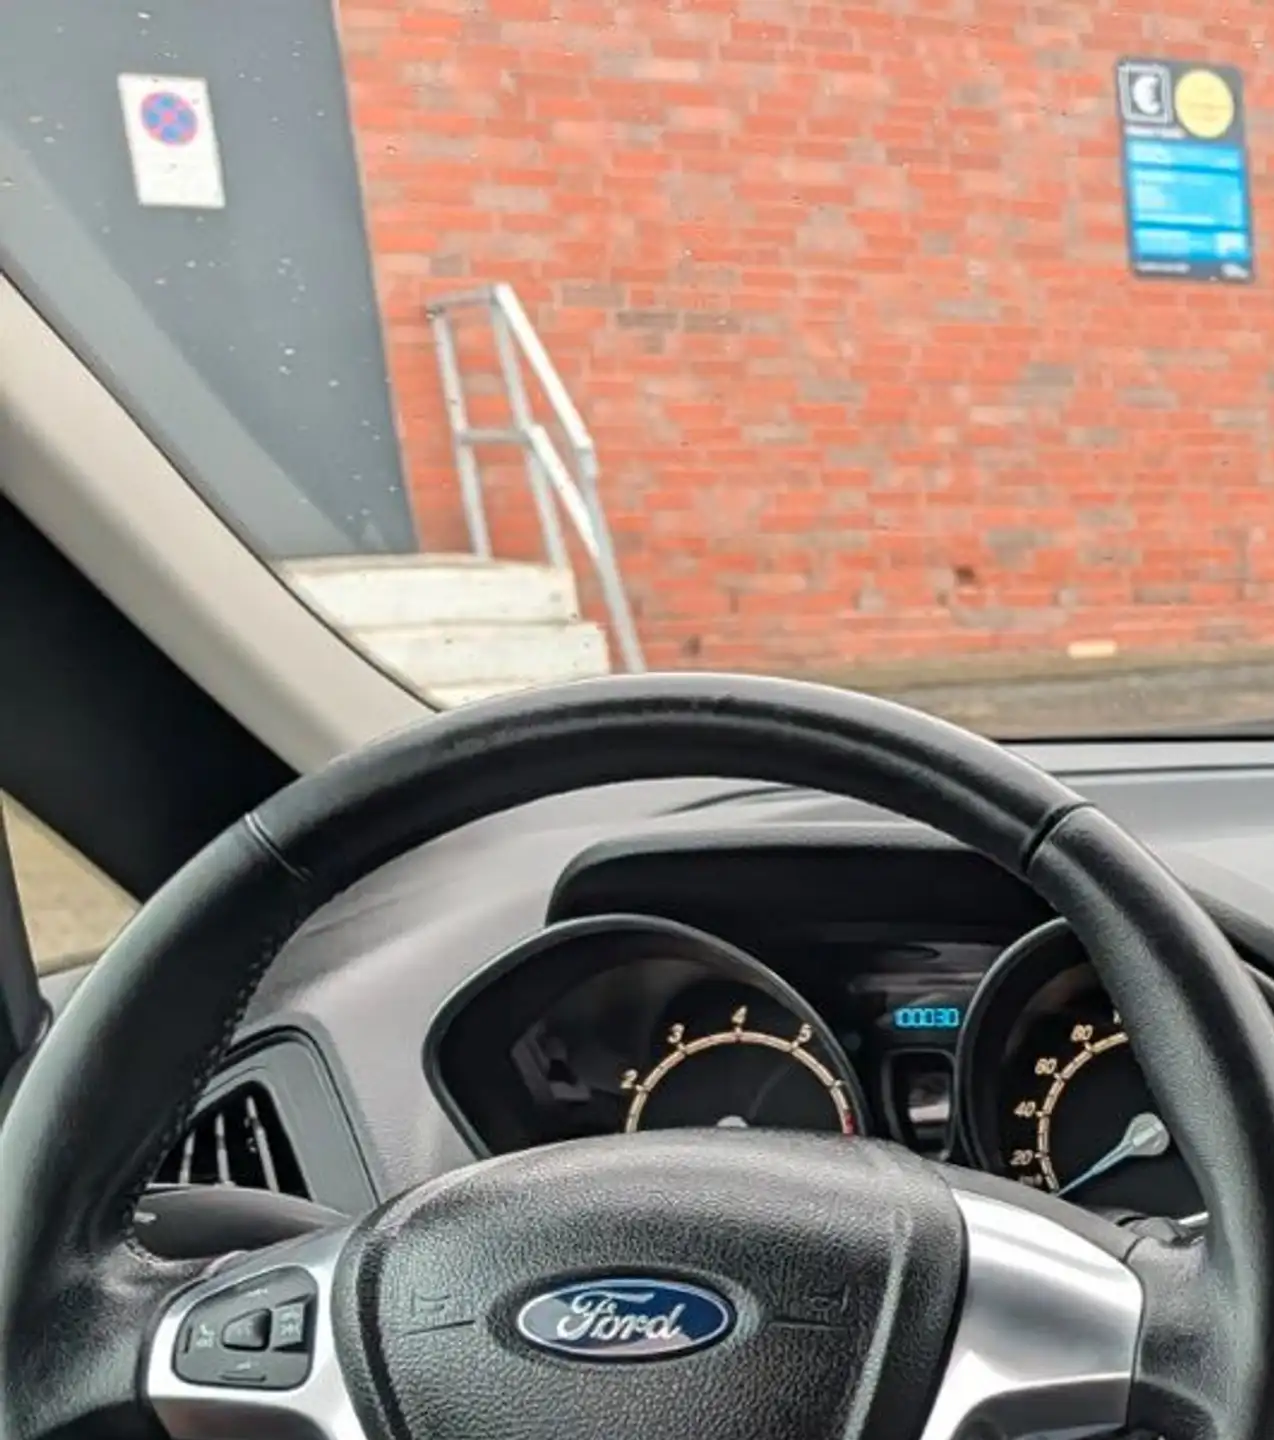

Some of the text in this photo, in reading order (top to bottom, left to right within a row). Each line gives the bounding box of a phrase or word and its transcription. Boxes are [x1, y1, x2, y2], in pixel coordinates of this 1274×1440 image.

[731, 1004, 747, 1024] 4
[667, 1022, 685, 1044] 3
[800, 1023, 812, 1042] 5
[620, 1068, 638, 1089] 2
[1014, 1101, 1036, 1117] 40
[1010, 1149, 1033, 1166] 20
[556, 1290, 687, 1340] Ford
